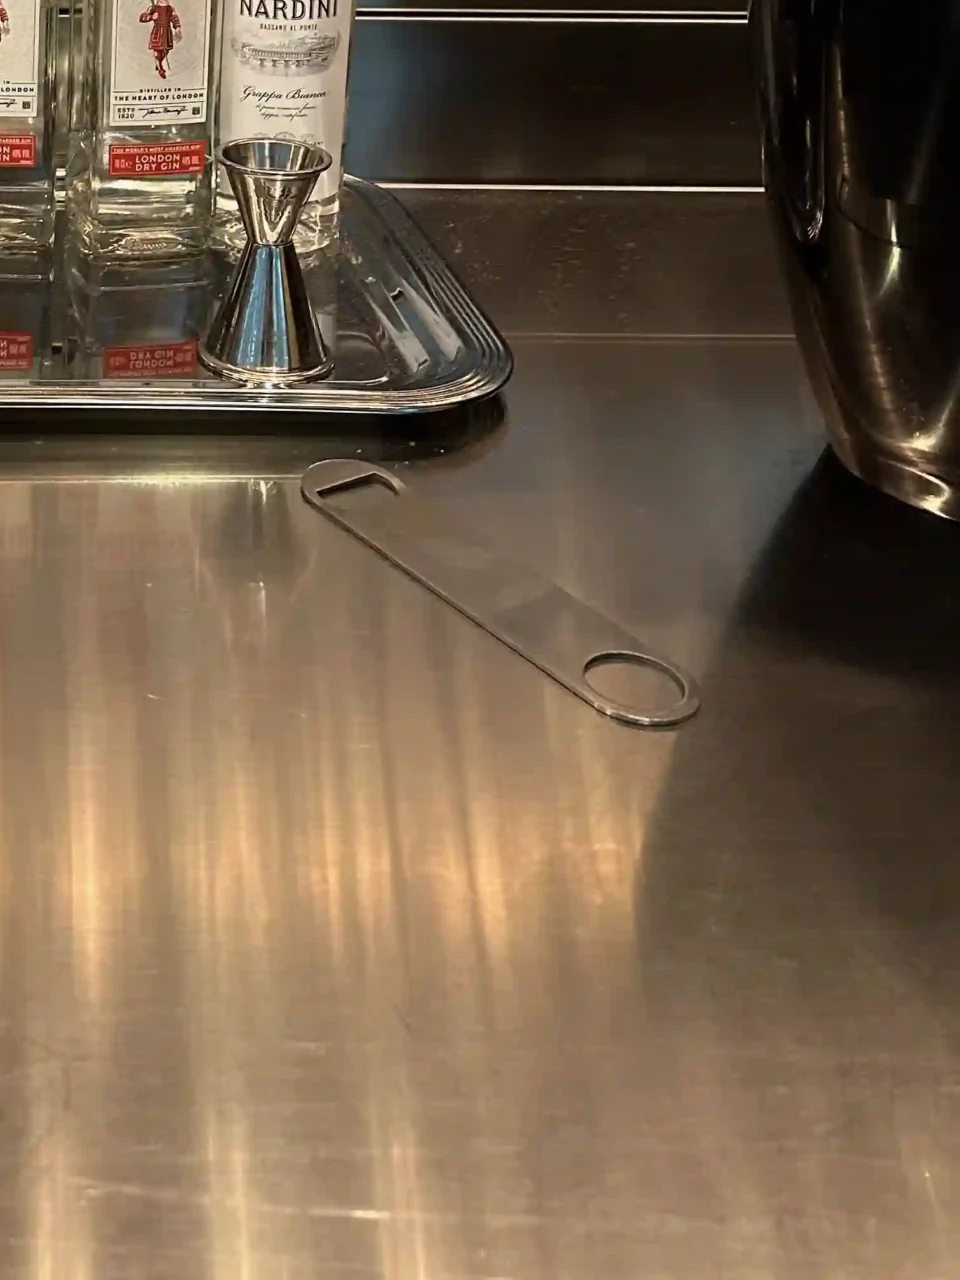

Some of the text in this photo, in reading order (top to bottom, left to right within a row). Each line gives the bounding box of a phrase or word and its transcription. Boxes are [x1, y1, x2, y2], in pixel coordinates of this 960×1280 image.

[172, 92, 204, 100] LONDON
[135, 154, 180, 163] LONDON
[135, 162, 158, 172] DRY
[160, 161, 180, 171] GIN
